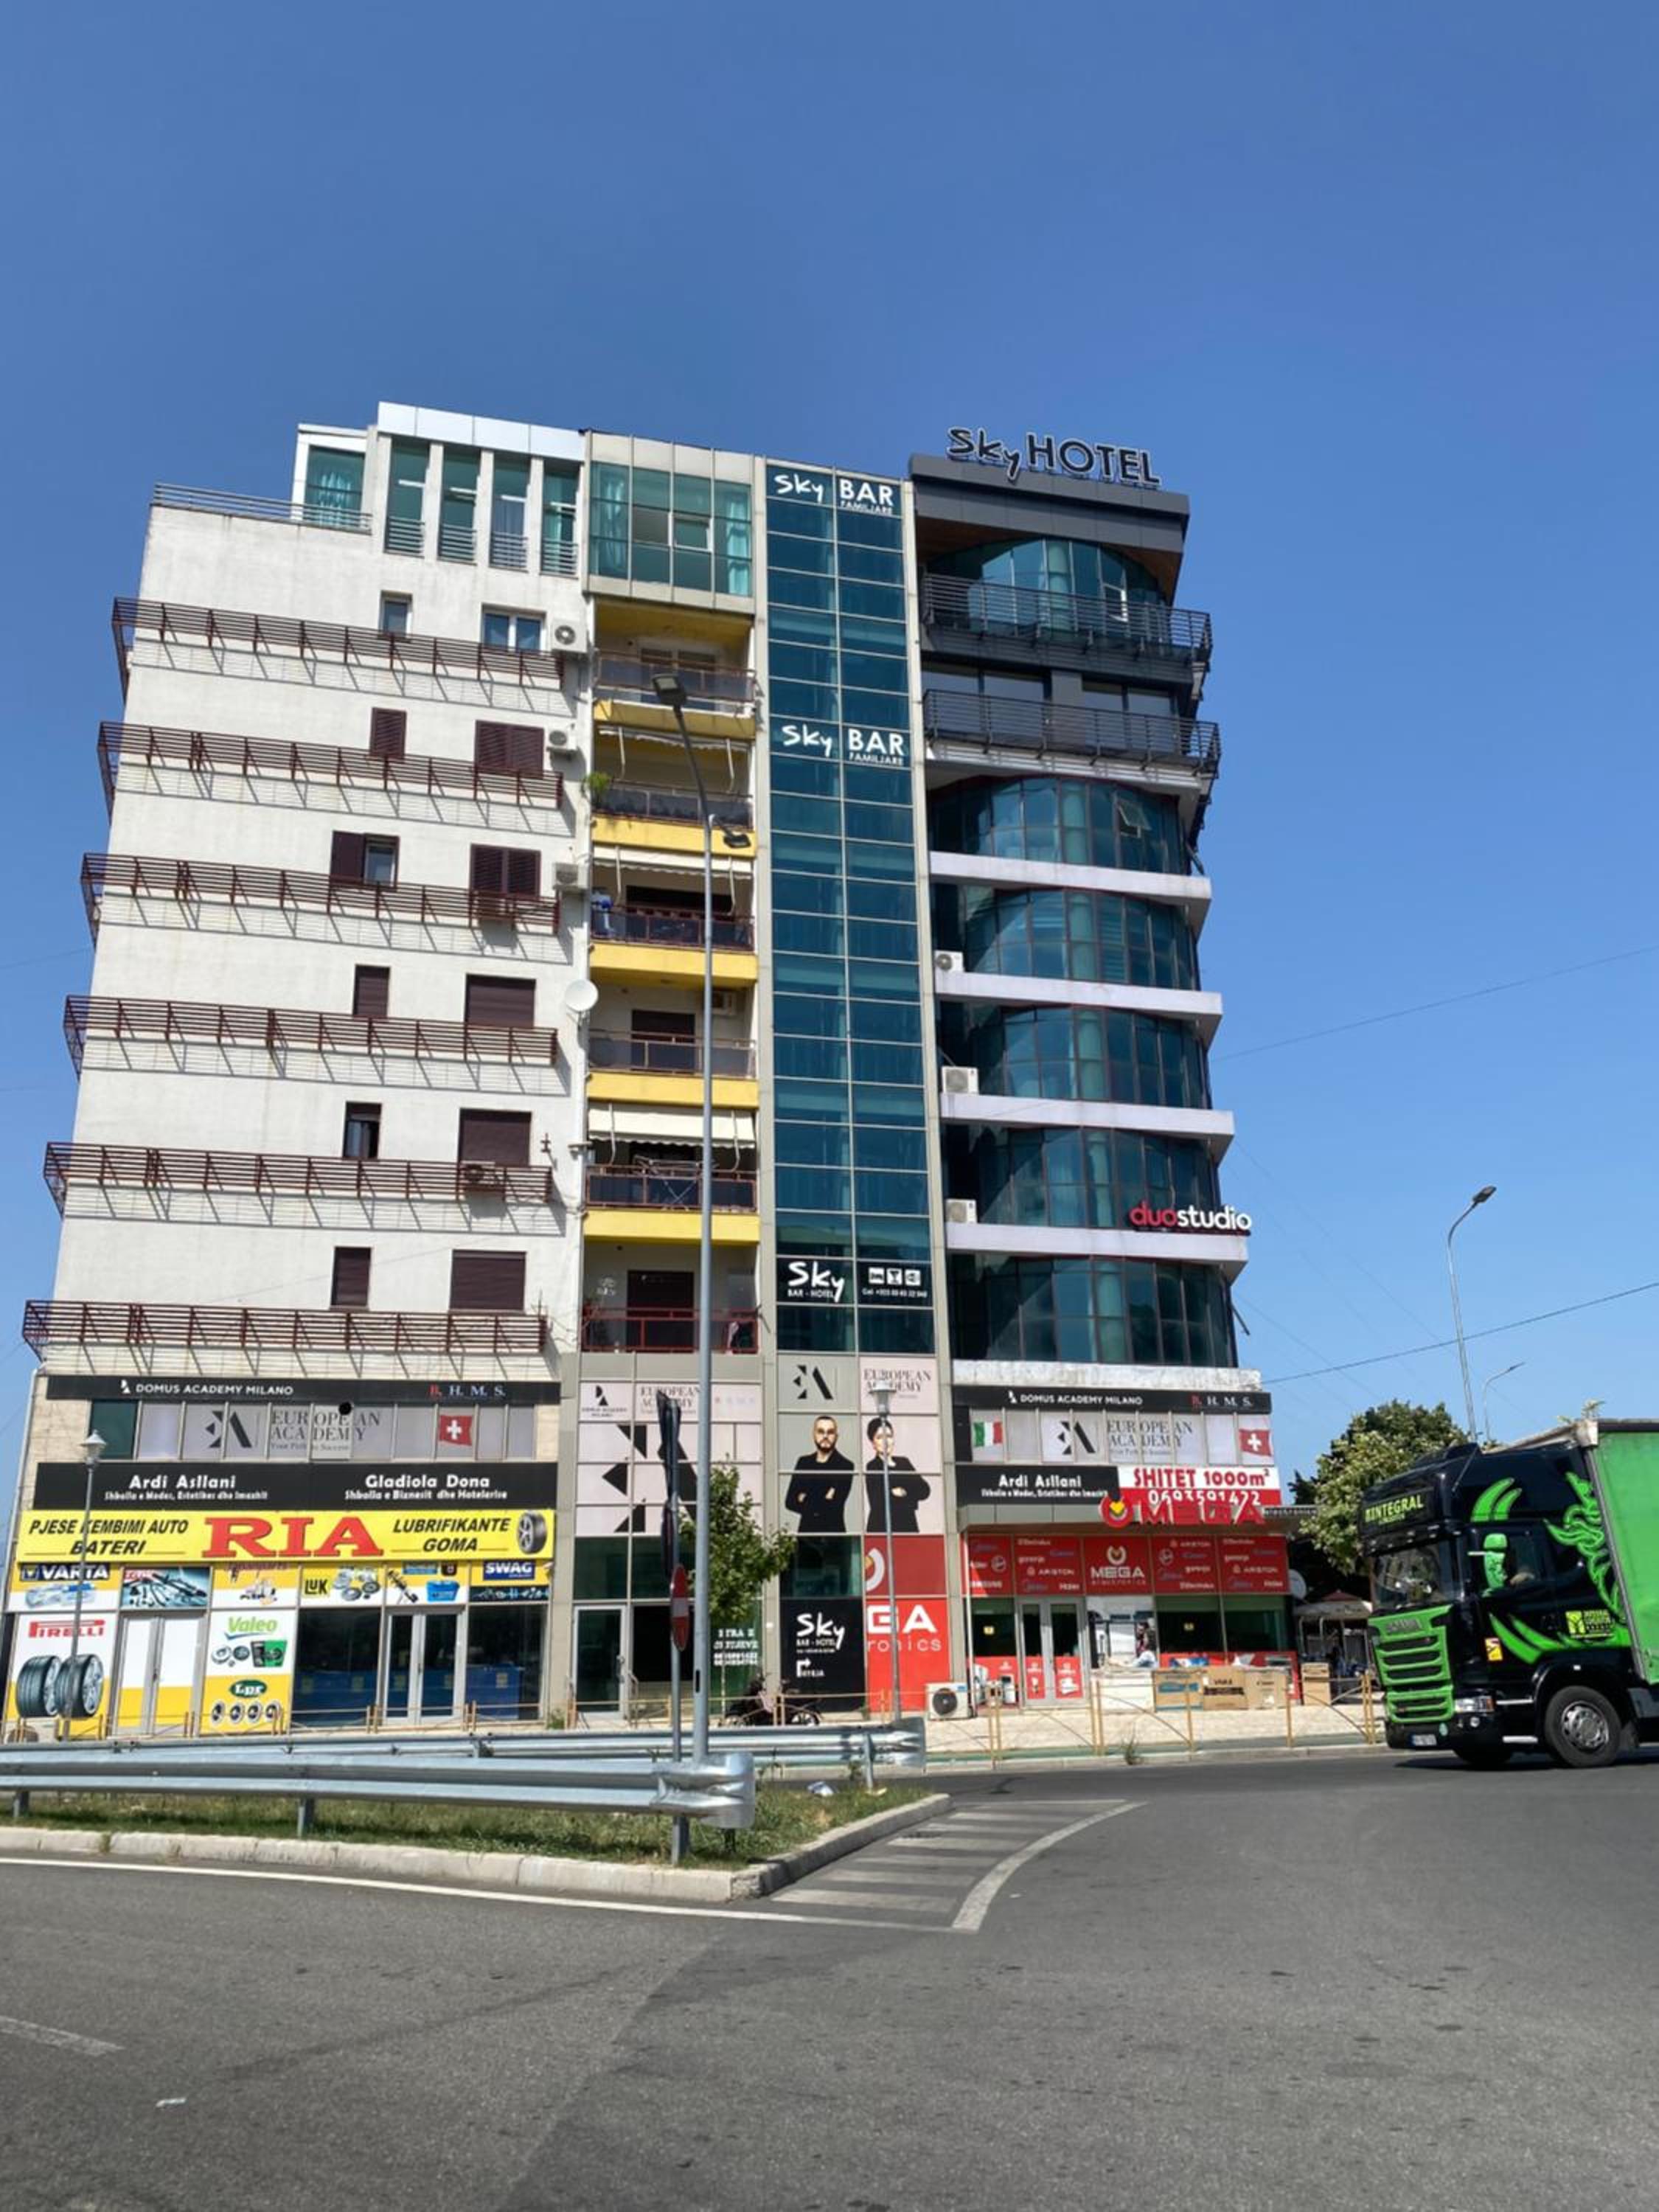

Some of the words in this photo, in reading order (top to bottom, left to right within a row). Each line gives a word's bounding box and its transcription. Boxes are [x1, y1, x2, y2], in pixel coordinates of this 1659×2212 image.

[947, 426, 1021, 481] Sky
[1026, 431, 1160, 486] HOTEL
[774, 473, 824, 504] Sky
[840, 479, 894, 507] BAR
[782, 723, 832, 758] Sky
[849, 728, 904, 756] BAR
[1130, 1200, 1252, 1230] duostudio
[787, 1260, 845, 1303] Sky
[135, 1383, 180, 1394] DOMUS
[184, 1384, 243, 1394] ACADEMY
[246, 1385, 294, 1395] MILANO
[1020, 1394, 1054, 1403] DOMUS
[1057, 1394, 1103, 1404] ACADEMY
[1105, 1396, 1142, 1405] MILANO
[272, 1409, 380, 1426] EUROPEAN
[271, 1426, 366, 1441] ACADEMY
[1107, 1419, 1192, 1433] EUROPEAN
[128, 1475, 168, 1489] Ardi
[175, 1475, 237, 1489] Asllani
[365, 1475, 437, 1489] Gladiola
[446, 1475, 490, 1488] Dona
[999, 1474, 1029, 1488] Ardi
[1035, 1474, 1082, 1488] Asllani
[1134, 1468, 1195, 1488] SHITET
[29, 1520, 78, 1534] PJESE
[147, 1520, 189, 1534] AUTO
[393, 1517, 511, 1534] LUBRIFIKANTE
[201, 1517, 384, 1558] RIA
[70, 1540, 147, 1555] BATERI
[423, 1538, 479, 1553] GOMA
[41, 1564, 108, 1579] VARTA
[485, 1561, 533, 1575] SWAG
[1090, 1565, 1145, 1578] MEGA
[29, 1619, 105, 1638] PIRELLI
[228, 1616, 278, 1633] Valeo
[796, 1613, 845, 1650] Sky
